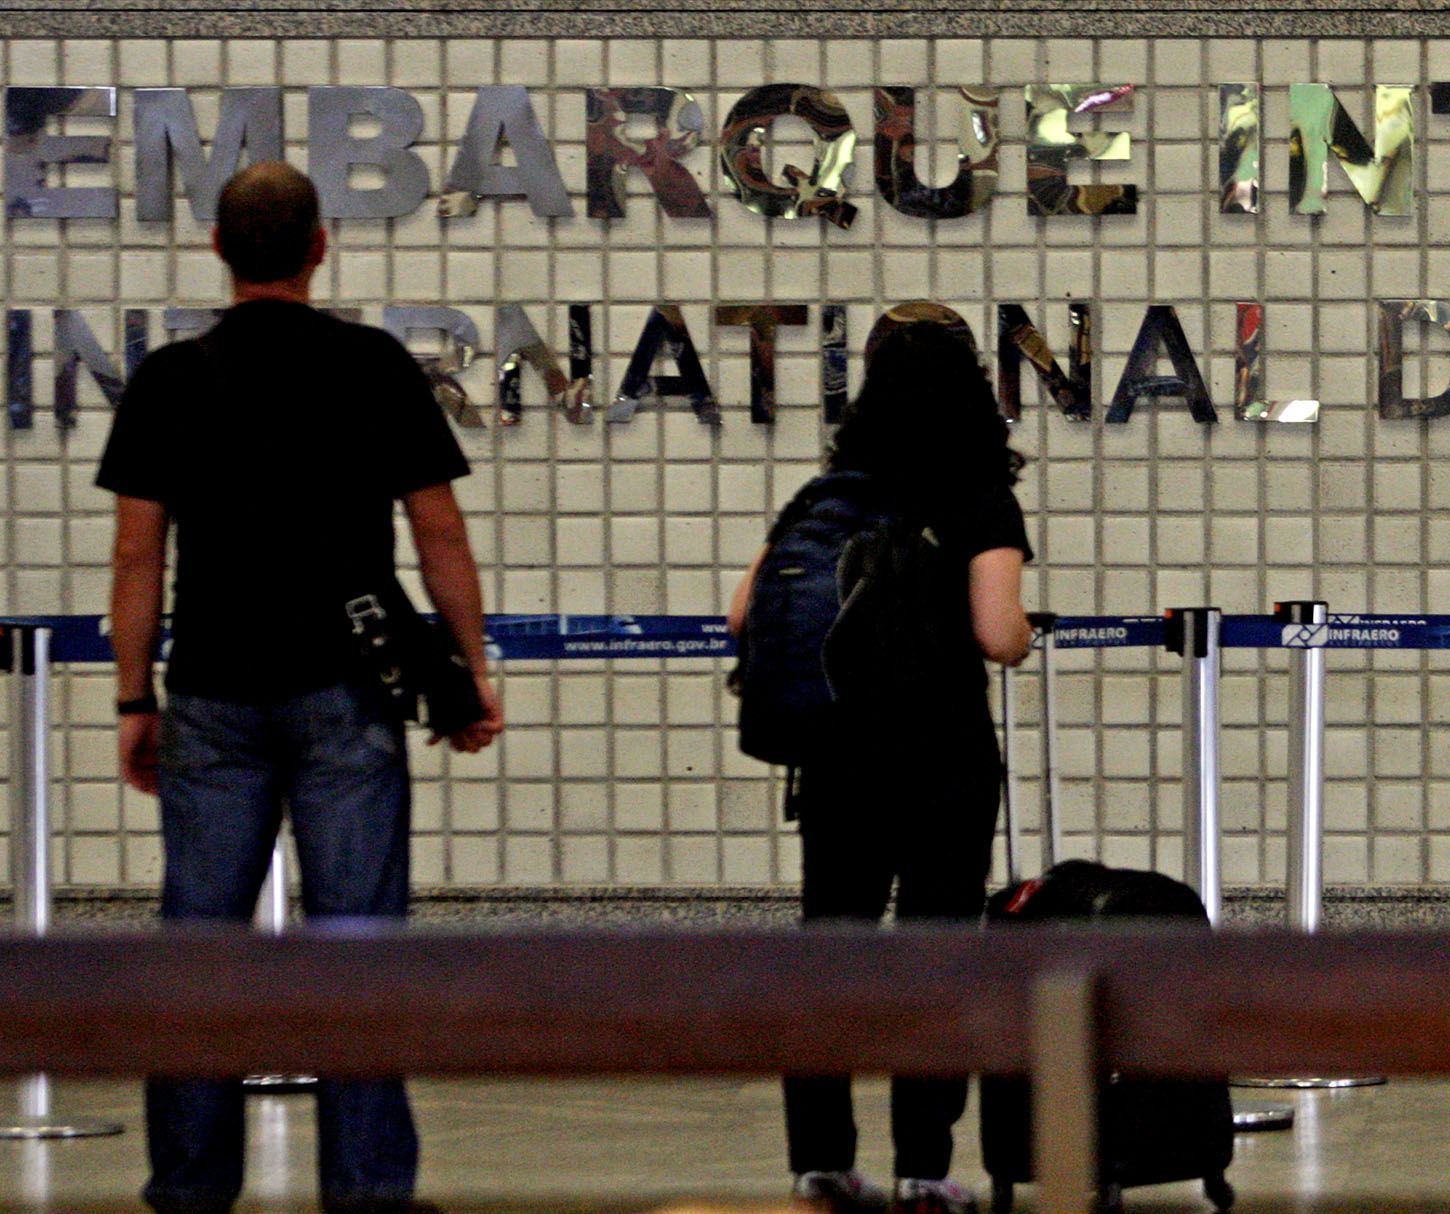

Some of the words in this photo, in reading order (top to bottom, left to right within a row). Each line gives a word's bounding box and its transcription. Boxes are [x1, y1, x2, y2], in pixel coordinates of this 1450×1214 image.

[5, 84, 1137, 229] EMBARQUE
[7, 301, 1320, 429] INRNATINAL
[1055, 627, 1127, 640] INFRAERO
[1329, 629, 1400, 641] INFRAERO
[564, 638, 727, 653] www.infraero.gov.br
